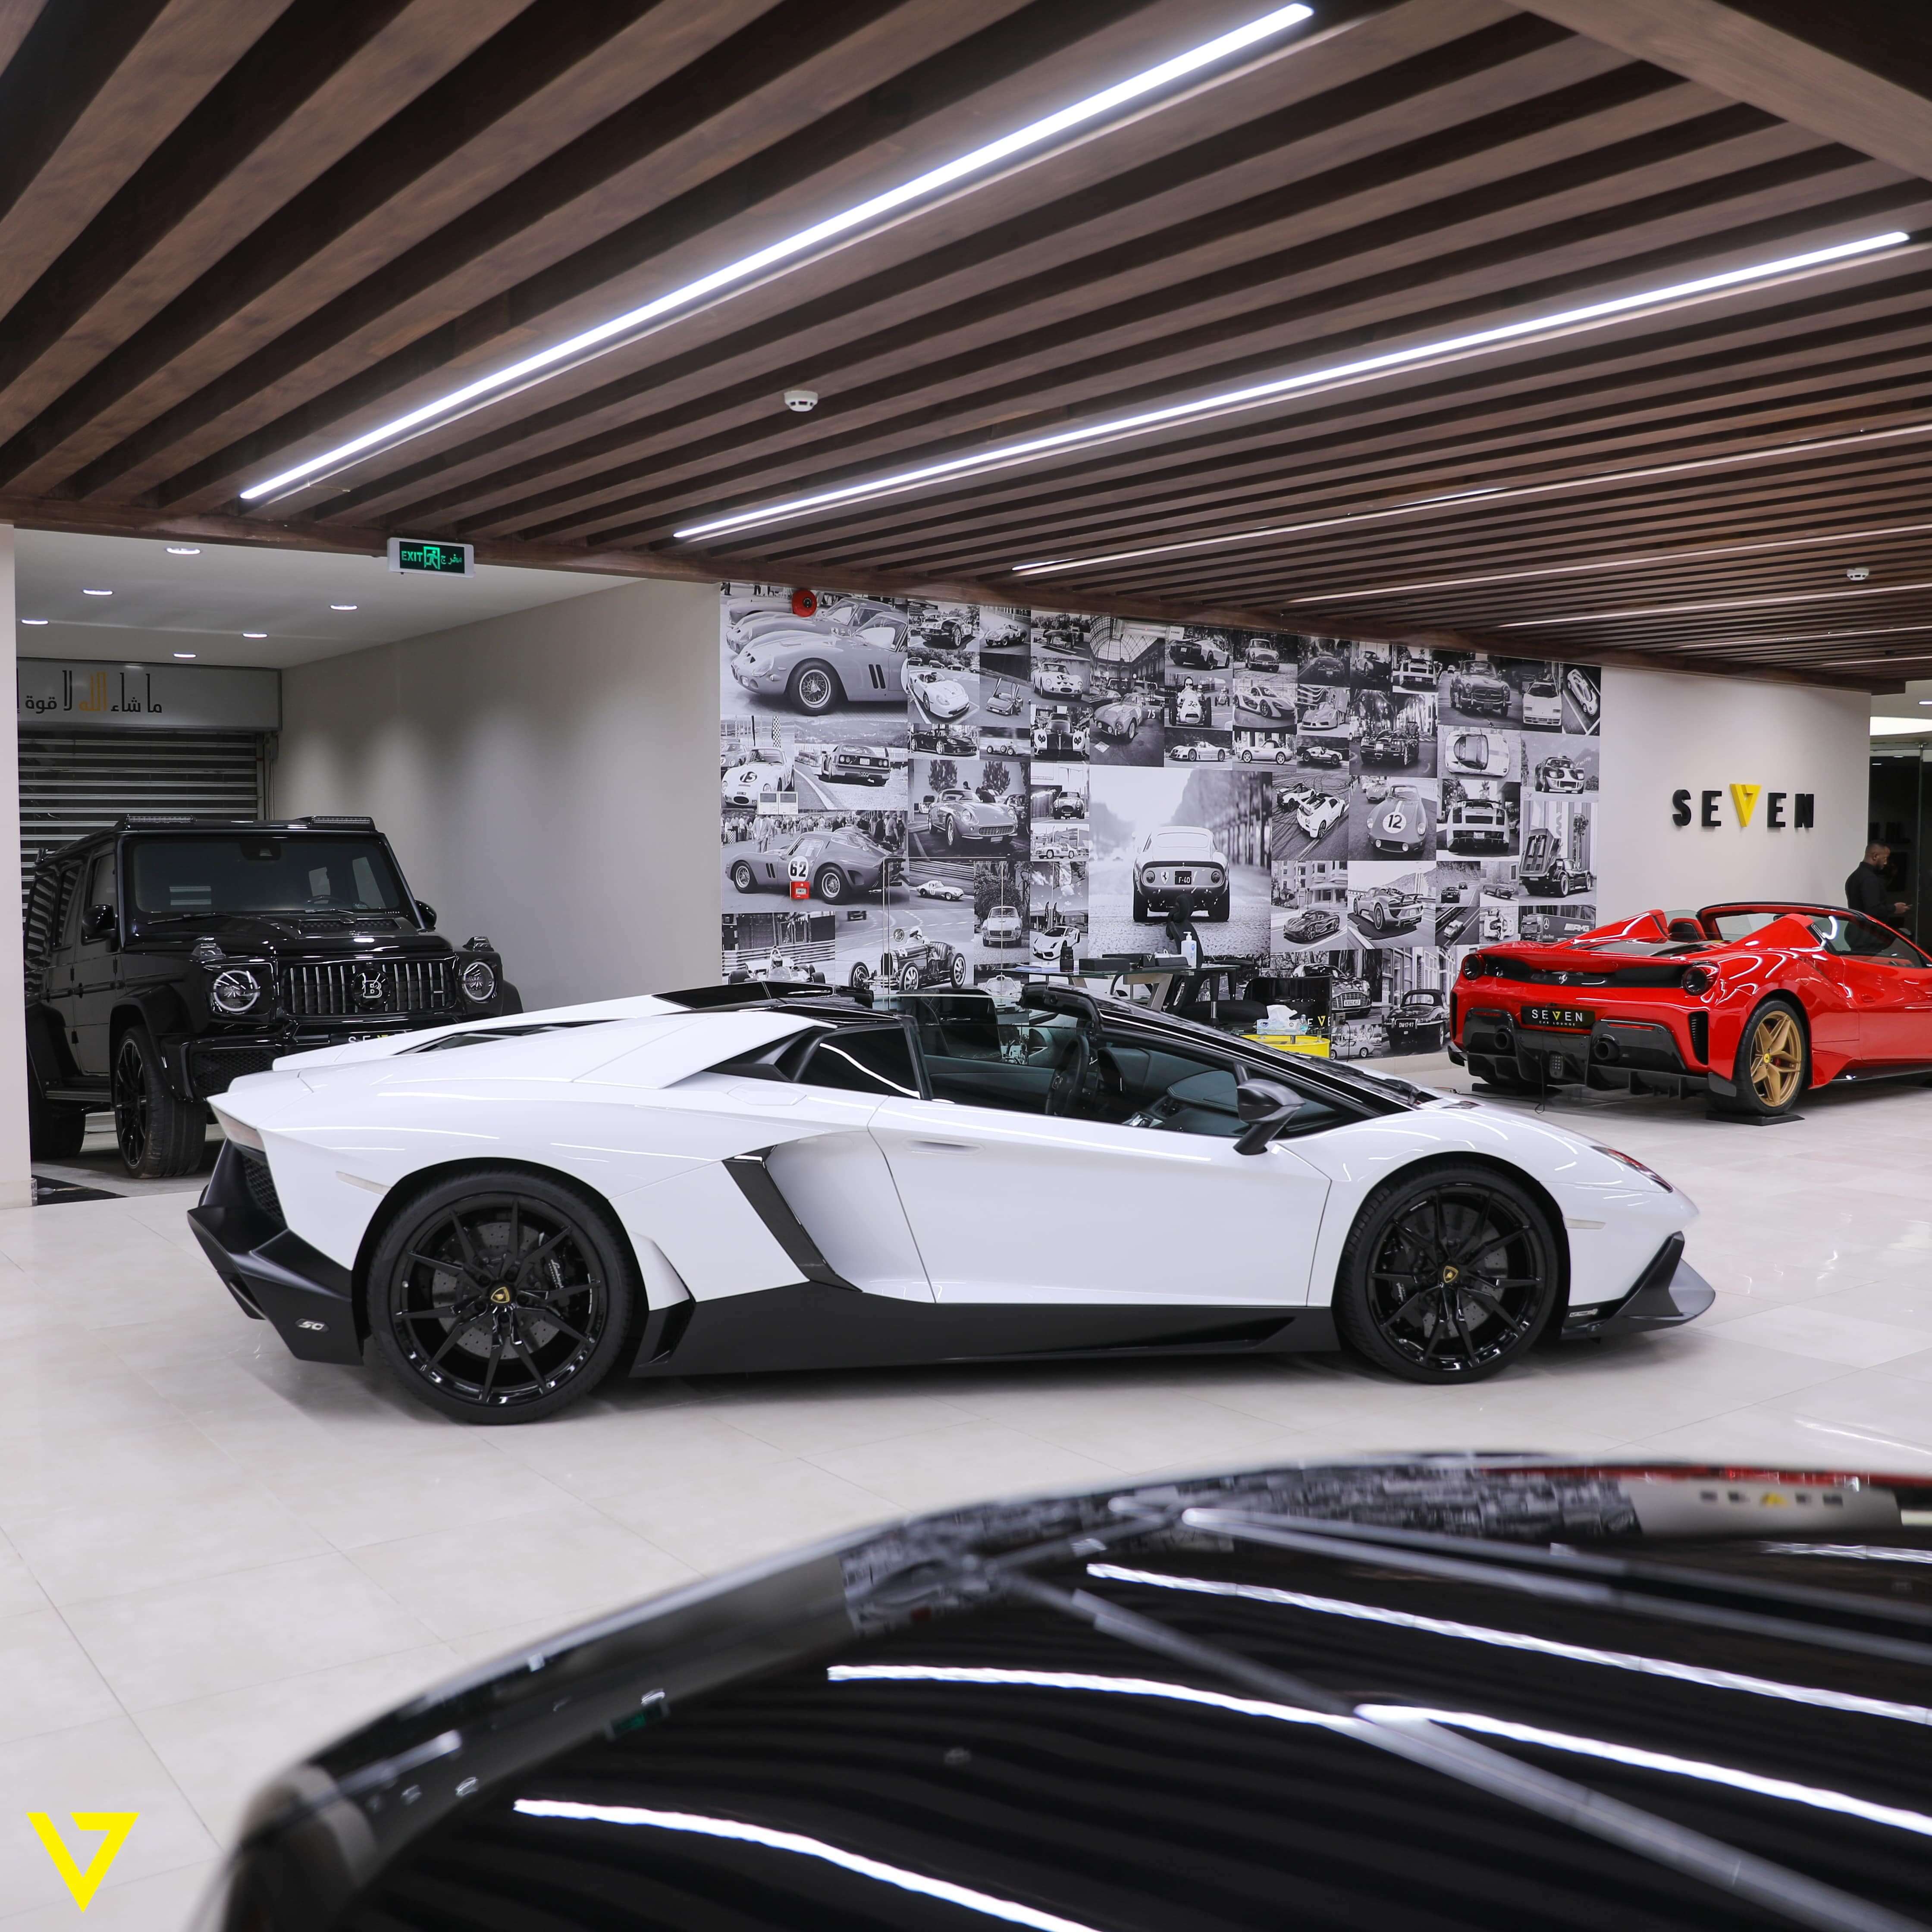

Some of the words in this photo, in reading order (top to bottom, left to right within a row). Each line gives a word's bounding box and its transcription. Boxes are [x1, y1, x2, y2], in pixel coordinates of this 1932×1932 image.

[401, 551, 423, 562] EXIT
[441, 554, 462, 565] مخرج
[62, 670, 72, 711] لا
[79, 671, 107, 712] الله
[111, 672, 141, 712] شاء
[146, 673, 162, 713] ما
[25, 695, 57, 714] قوة
[1148, 709, 1156, 719] 75
[1672, 783, 1814, 828] SEVEN
[1388, 815, 1402, 829] 12
[790, 861, 806, 877] 62
[1531, 1009, 1583, 1022] SEVEN
[298, 1320, 325, 1331] 50
